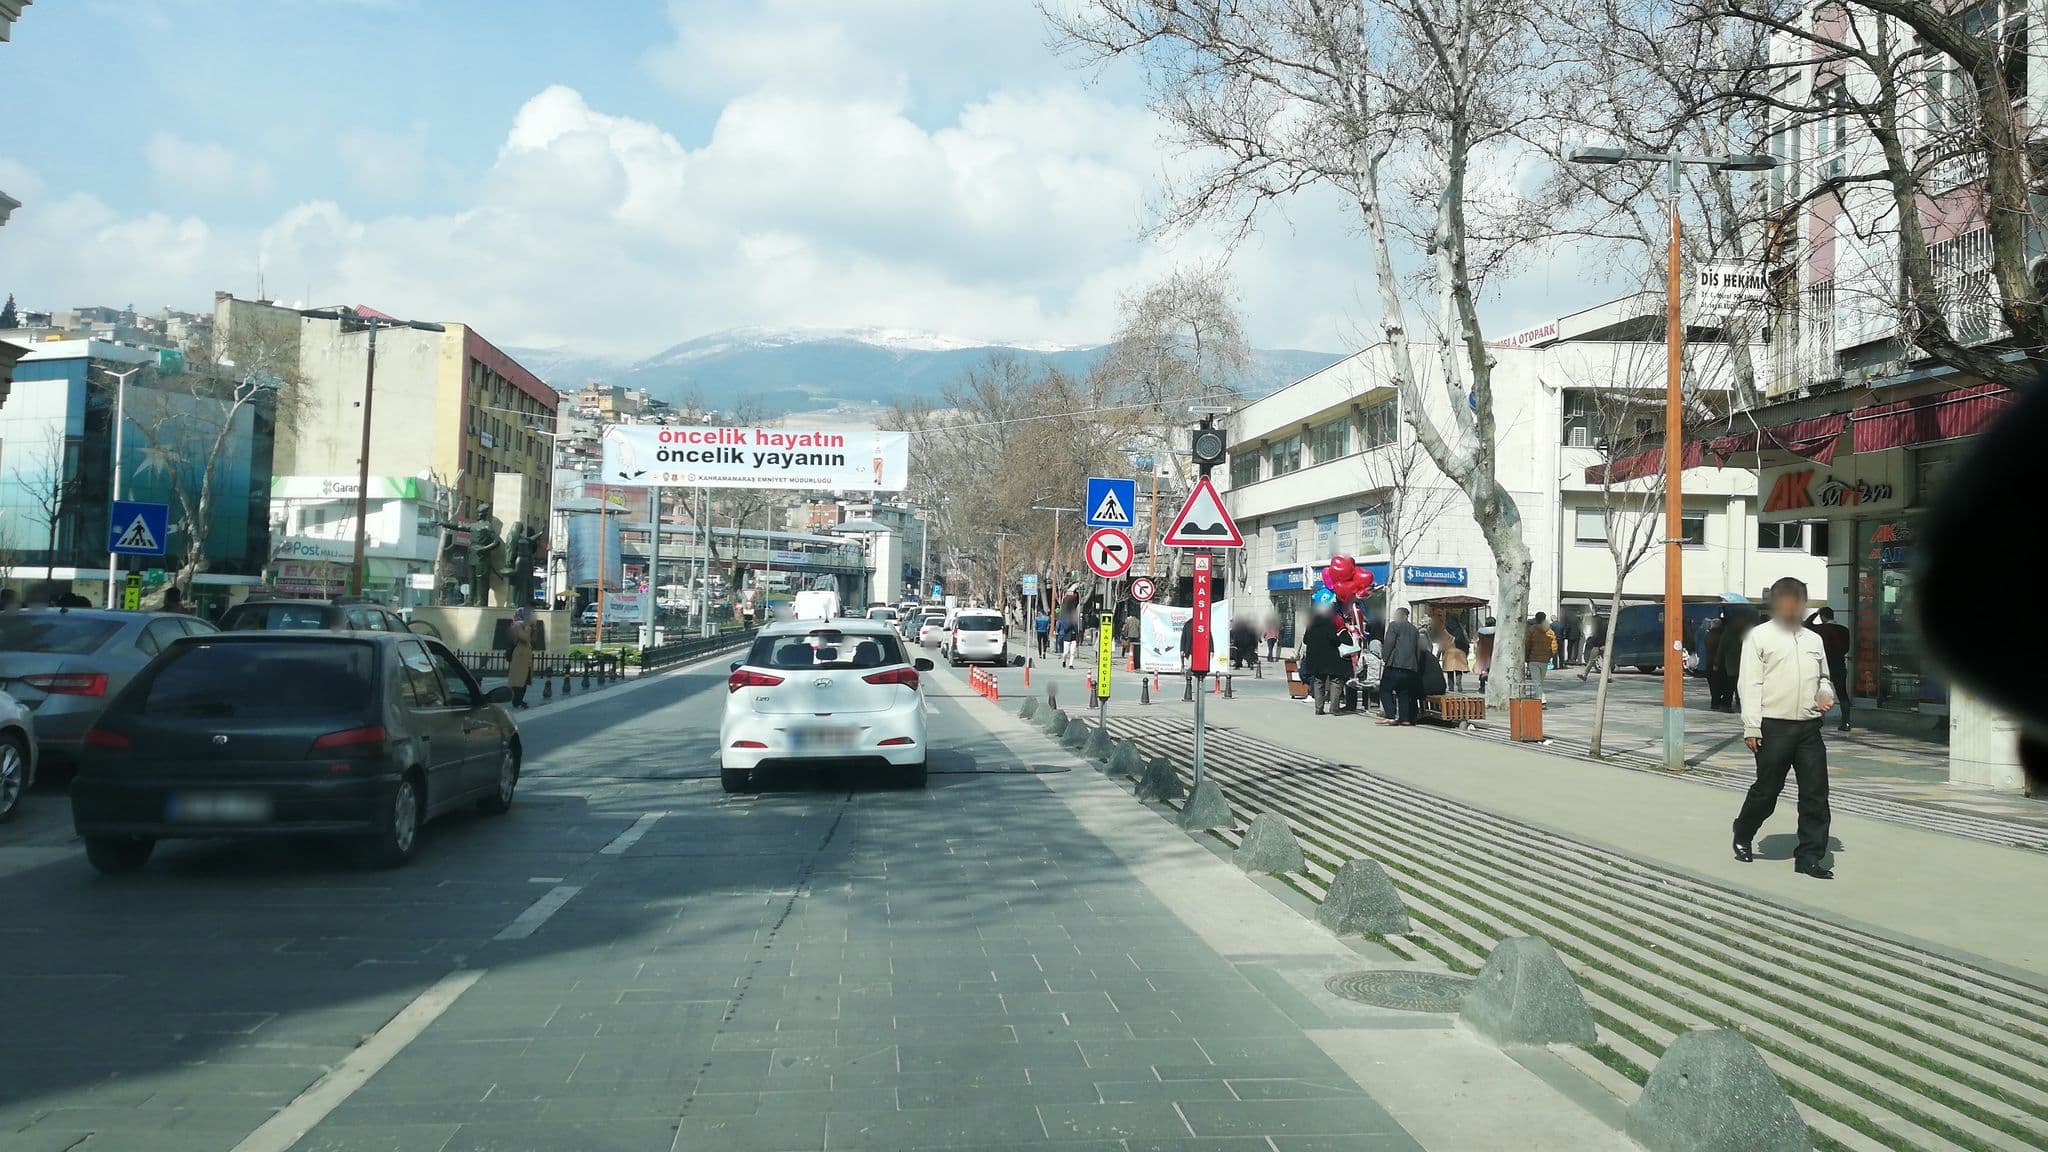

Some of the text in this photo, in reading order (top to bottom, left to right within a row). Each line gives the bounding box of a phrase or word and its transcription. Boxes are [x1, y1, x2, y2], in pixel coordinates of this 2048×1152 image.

[1519, 323, 1556, 344] OTOPARK
[658, 427, 844, 450] öncelik hayatın
[656, 446, 845, 469] öncelik yayanın
[333, 482, 360, 493] Garan
[1763, 469, 1892, 512] AK turizm
[1415, 570, 1457, 579] Bankamatik
[1197, 575, 1206, 633] KASİS
